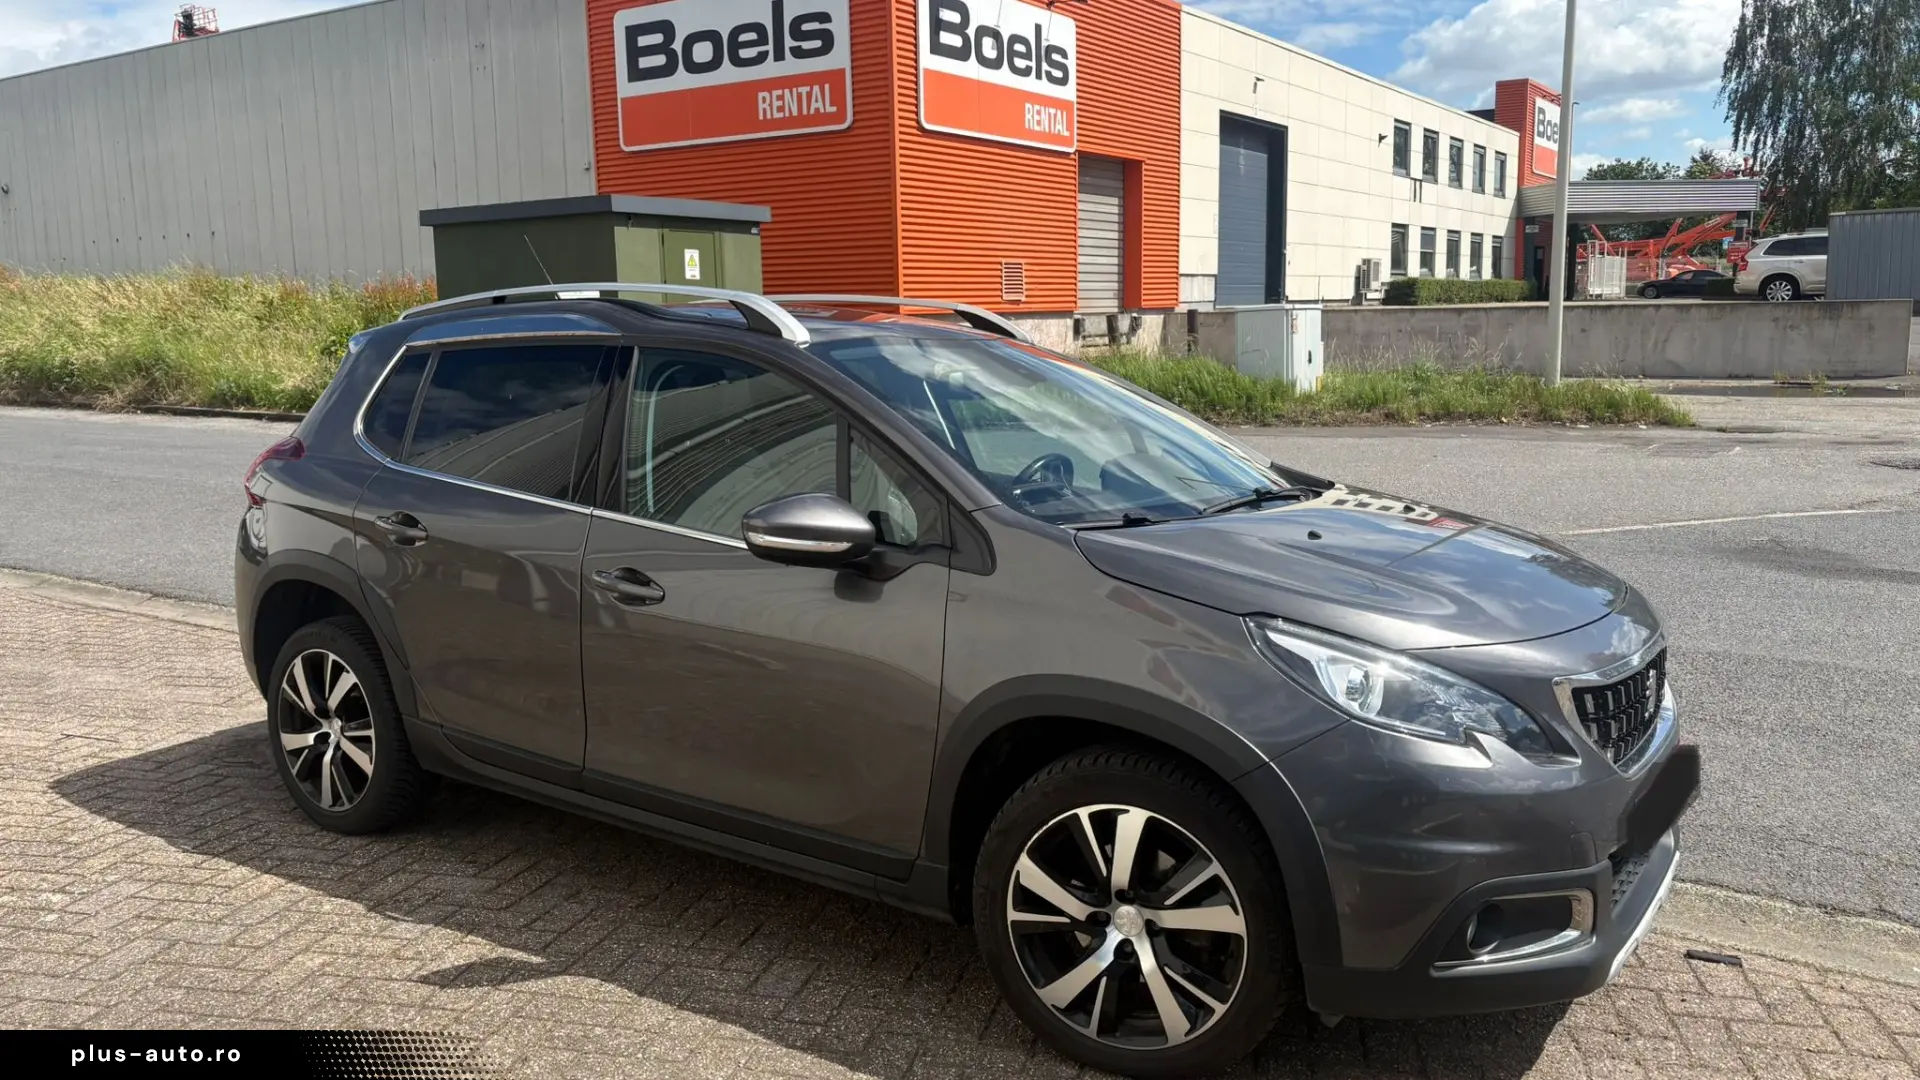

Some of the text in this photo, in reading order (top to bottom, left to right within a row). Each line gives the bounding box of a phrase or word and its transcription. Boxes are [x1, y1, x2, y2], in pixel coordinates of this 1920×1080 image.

[625, 0, 835, 83] Boels
[929, 0, 1070, 87] Boels
[757, 83, 837, 120] RENTAL
[1024, 102, 1070, 137] RENTAL
[1536, 106, 1559, 144] Boe
